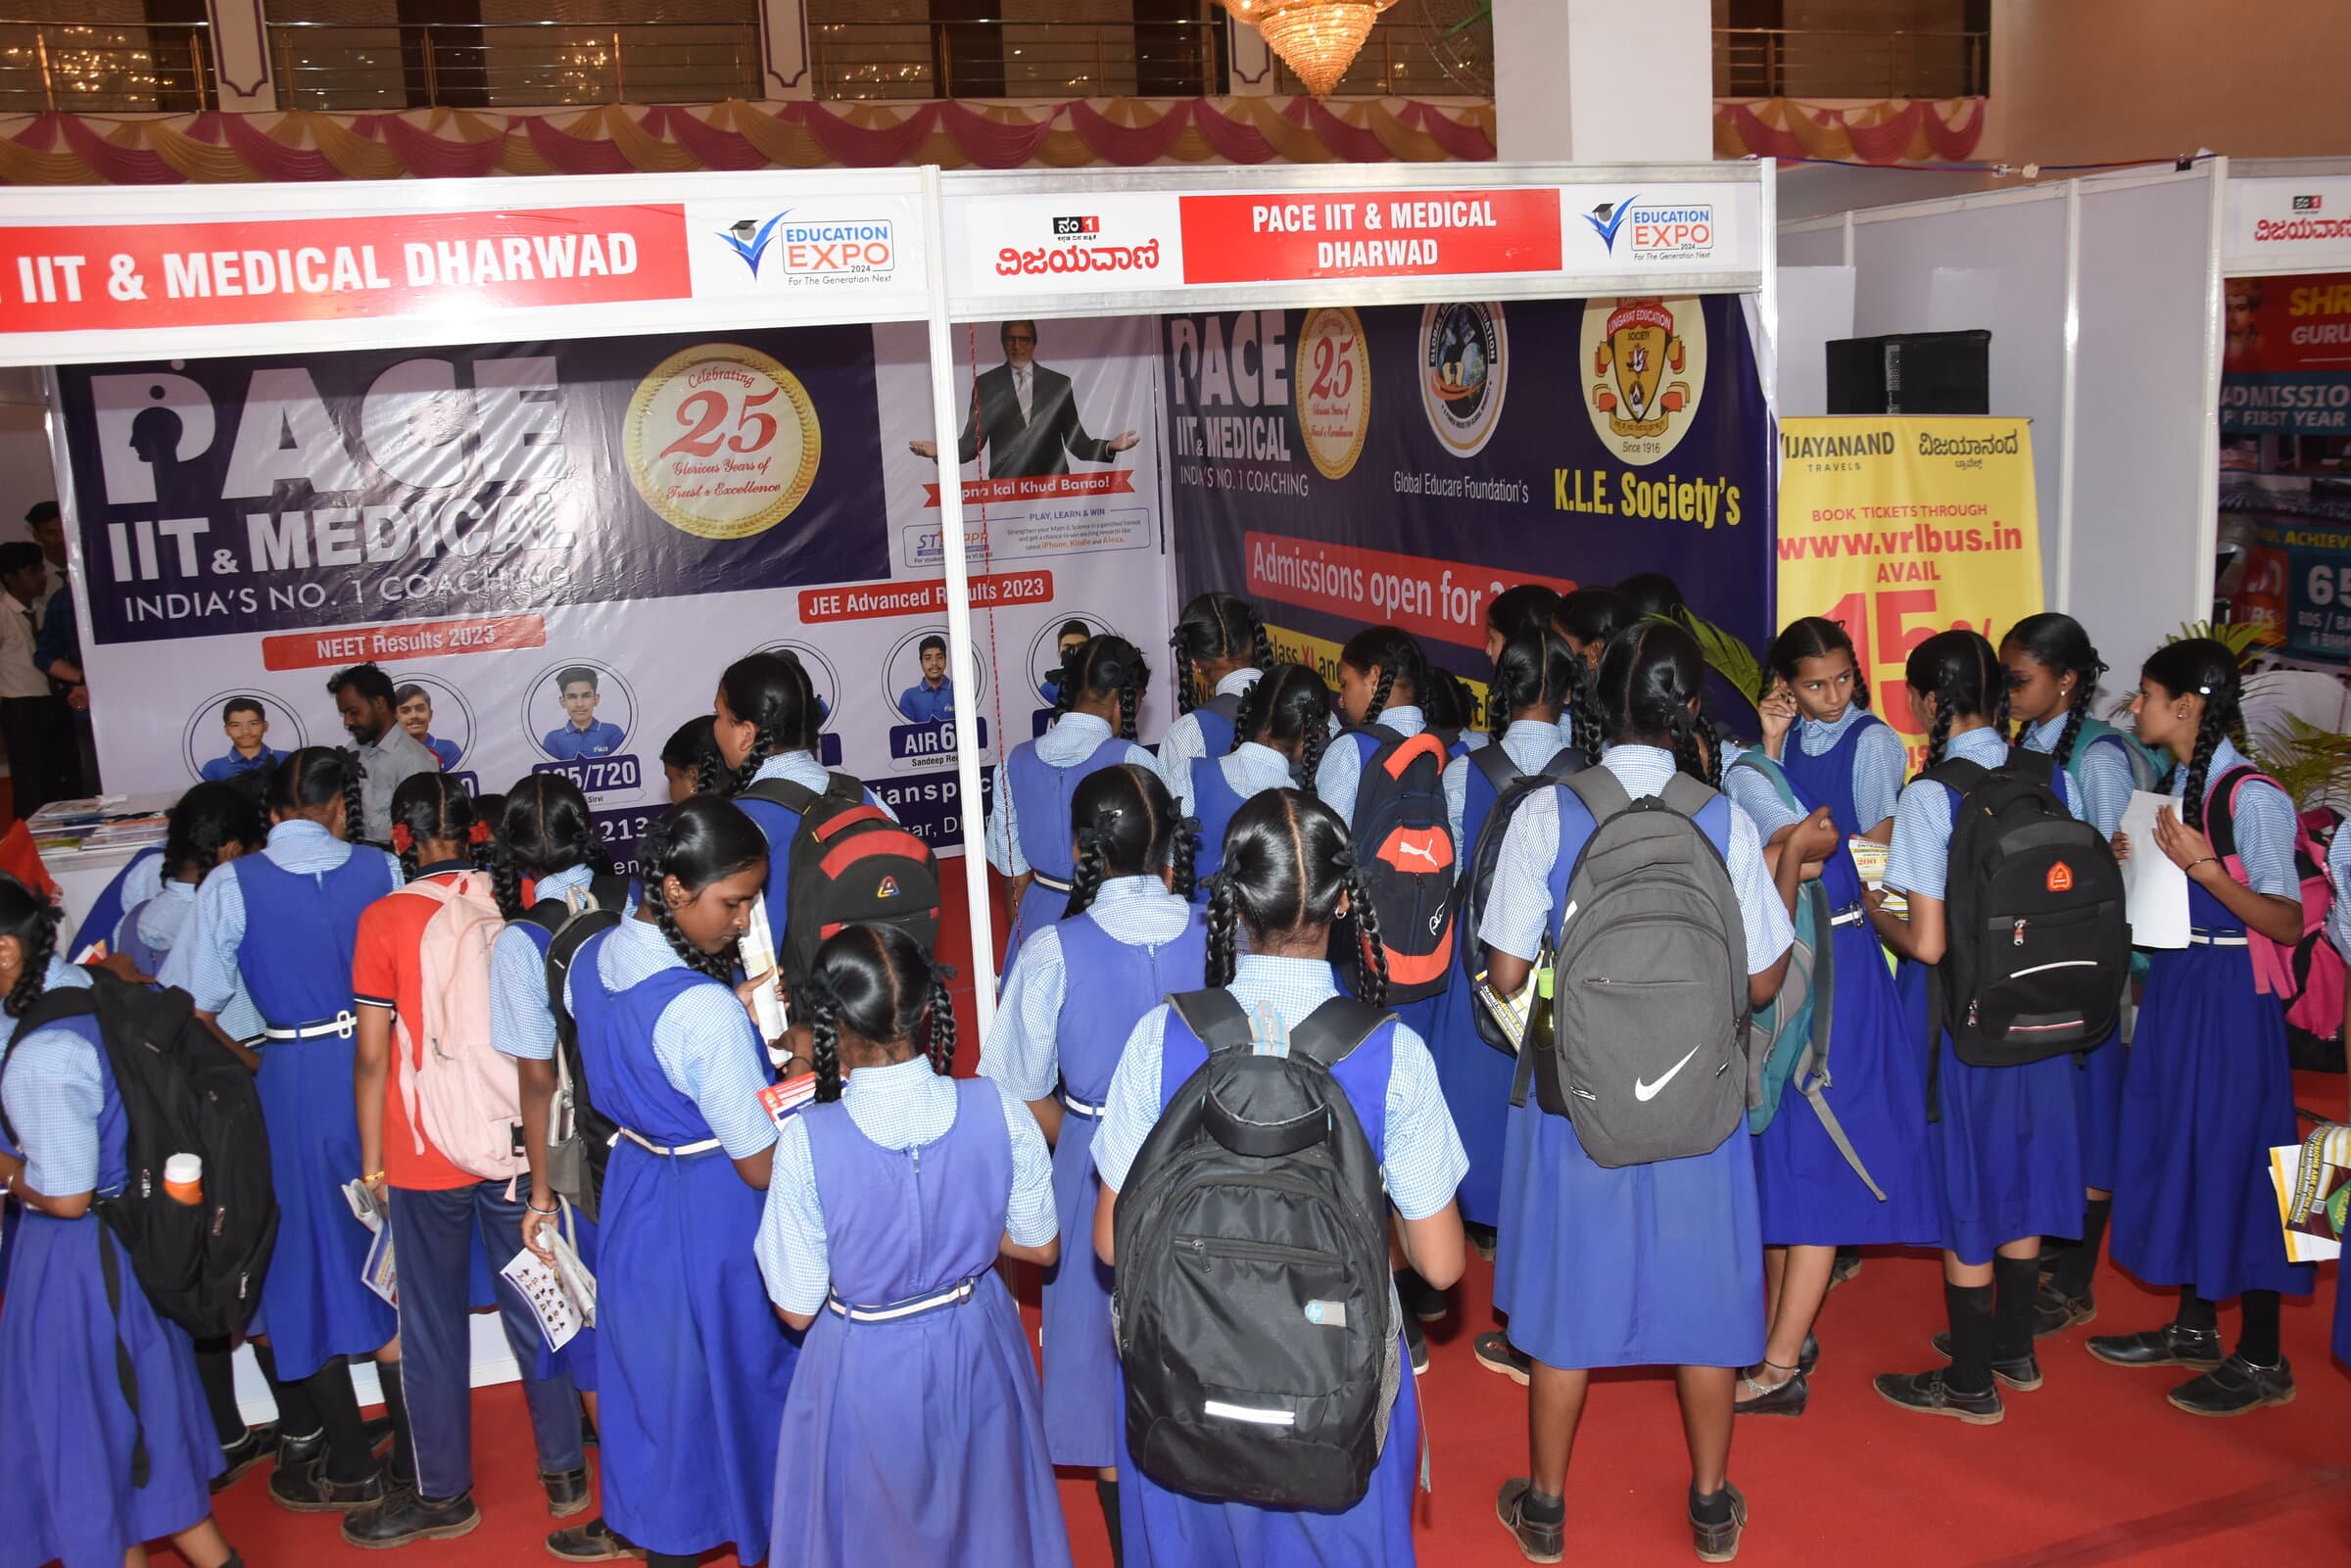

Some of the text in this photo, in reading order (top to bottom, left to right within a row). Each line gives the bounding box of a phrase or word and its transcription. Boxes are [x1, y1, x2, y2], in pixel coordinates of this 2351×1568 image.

[1253, 200, 1497, 233] PACE IIT & MEDICAL
[1634, 211, 1709, 223] EDUCATION
[787, 226, 888, 243] EDUCATION
[1635, 224, 1710, 247] EXPO
[18, 231, 638, 304] IIT & MEDICAL DHARWAD
[788, 242, 889, 270] EXPO
[996, 238, 1159, 276] ವಿಜಯವಾಣಿ
[1318, 238, 1439, 269] DHARWAD
[1659, 252, 1694, 261] Generation
[789, 274, 891, 286] For The Generation Next
[850, 264, 871, 273] 2024
[1636, 309, 1671, 330] EDUCATION
[1171, 309, 1289, 406] PACE
[1309, 335, 1354, 400] 25
[688, 366, 756, 389] Celebrating
[91, 356, 566, 505] PACE
[659, 387, 779, 459] 25
[2241, 409, 2288, 427] FIRST
[2292, 410, 2347, 427] YEAR
[1176, 415, 1291, 462] IIT & MEDICAL
[1622, 441, 1660, 454] Since 1916
[1919, 428, 2019, 456] ವಿಜಯಾನಂದ
[672, 456, 772, 476] Glorious Years of
[1807, 462, 1861, 473] TRAVELS
[666, 485, 701, 499] Trust
[714, 481, 781, 497] Excellence
[993, 482, 1015, 497] kal
[1021, 478, 1056, 493] Khud
[1061, 476, 1110, 491] Banao!
[1217, 467, 1236, 491] NO.
[1238, 468, 1243, 491] 1
[1247, 469, 1310, 497] COACHING
[1394, 471, 1529, 503] Global Educare Foundation's
[1555, 468, 1741, 529] K.L.E. Society's
[1812, 503, 1988, 522] BOOK TICKETS THROUGH
[1030, 511, 1053, 522] PLAY,
[1054, 509, 1081, 520] LEARN
[1090, 507, 1105, 517] WIN
[106, 493, 575, 582] IIT & MEDICAL
[1777, 521, 2023, 561] www.vrlbus.in
[1253, 541, 1482, 626] Admissions open for
[1877, 561, 1942, 584] AVAIL
[124, 563, 571, 623] INDIA'S NO. 1 COACHING
[809, 578, 1044, 616] JEE Advanced Rults 2023
[317, 626, 496, 659] NEET Results 2023
[906, 728, 937, 756] AIR
[912, 756, 944, 768] Sandeep
